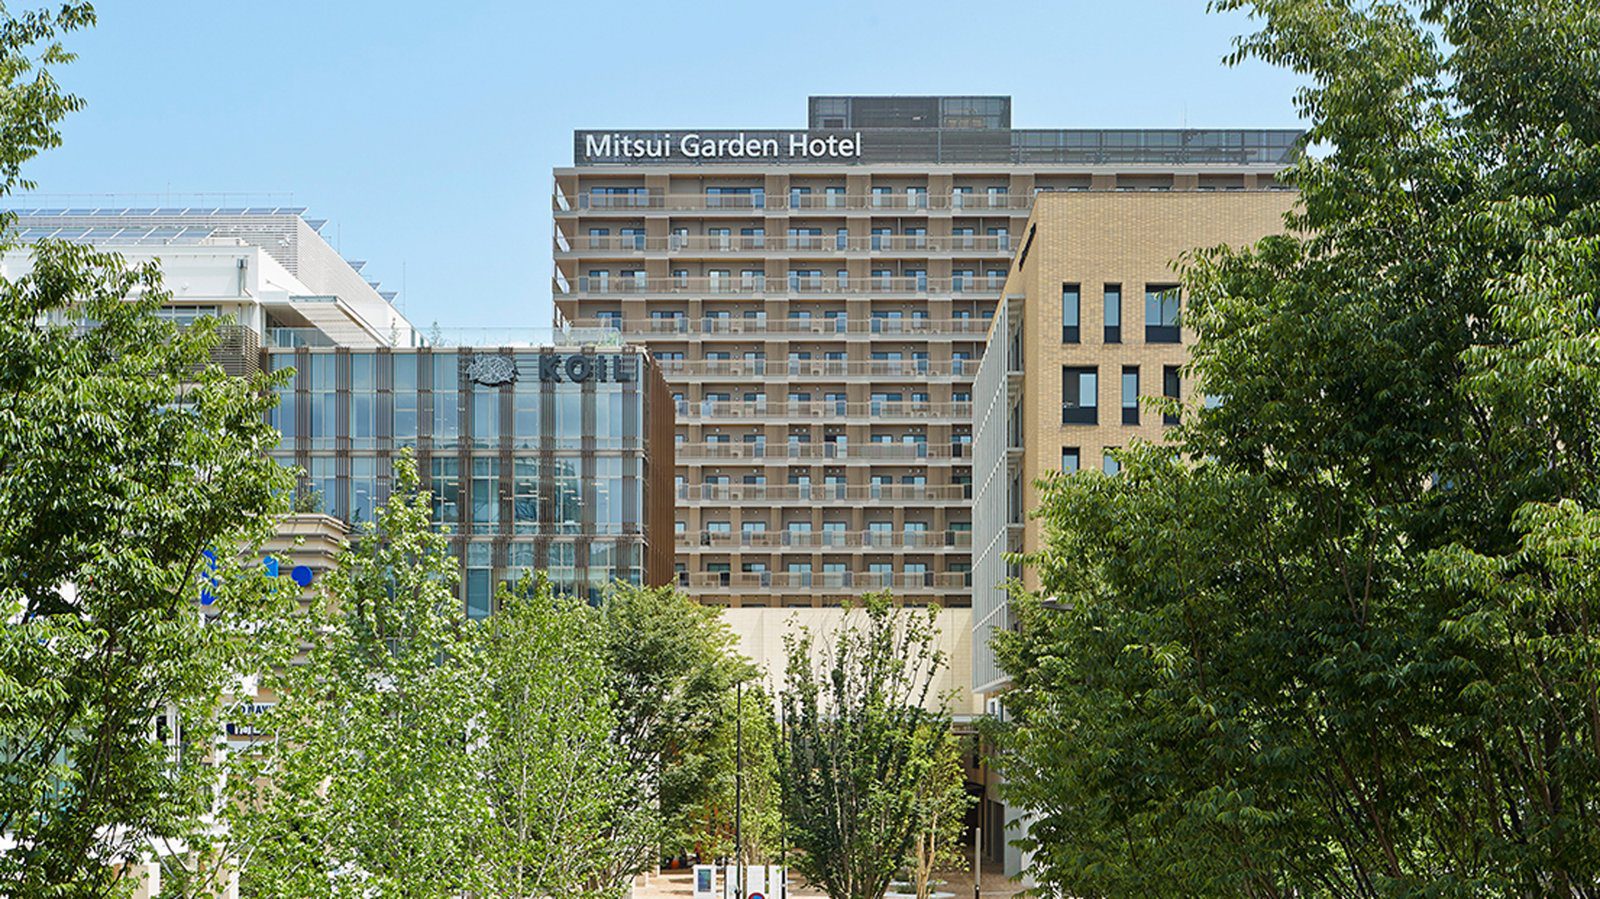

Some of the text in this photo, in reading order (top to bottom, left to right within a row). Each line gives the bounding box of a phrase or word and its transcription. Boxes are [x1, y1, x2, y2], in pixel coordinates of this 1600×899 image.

[585, 132, 861, 157] Mitsui Garden Hotel
[539, 354, 635, 383] KOIL
